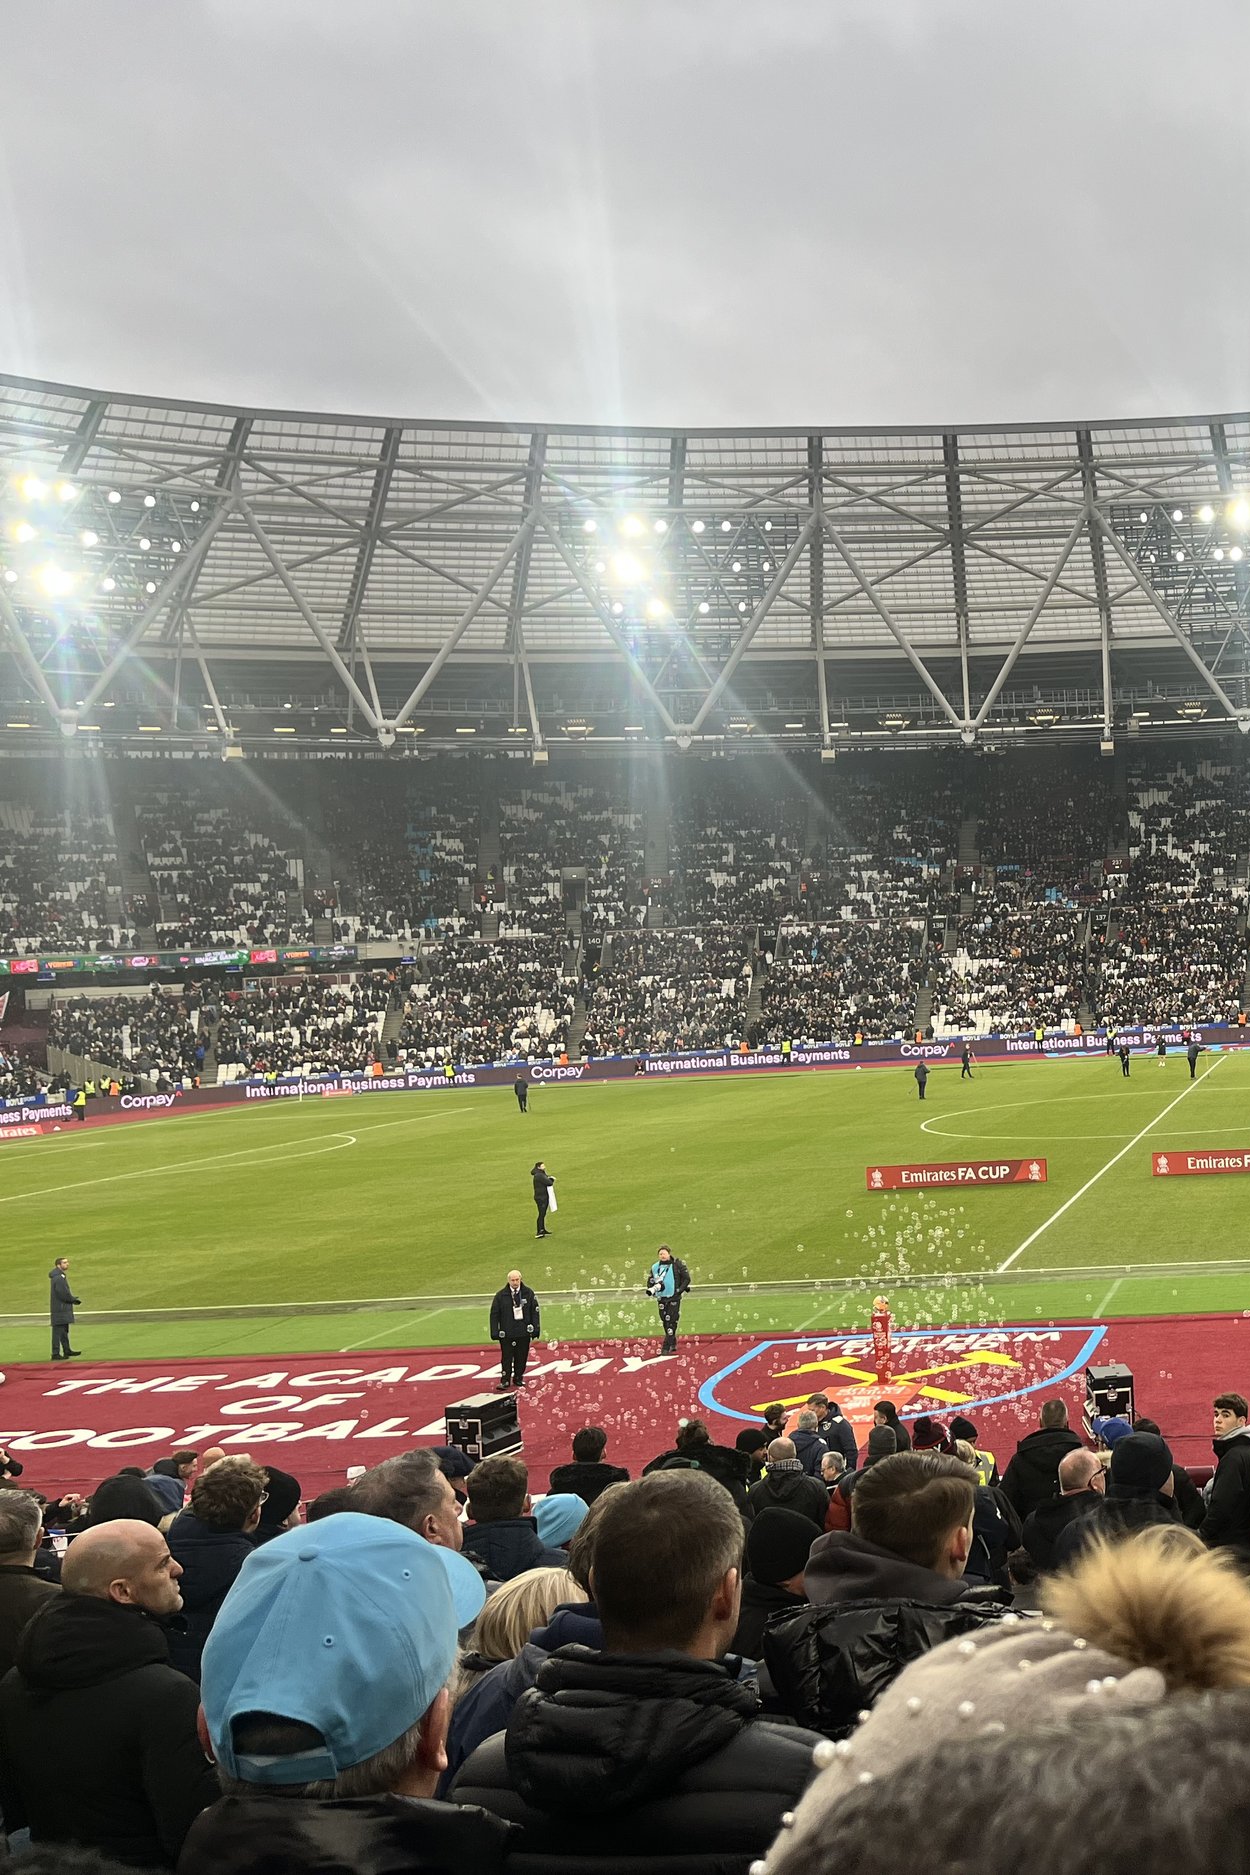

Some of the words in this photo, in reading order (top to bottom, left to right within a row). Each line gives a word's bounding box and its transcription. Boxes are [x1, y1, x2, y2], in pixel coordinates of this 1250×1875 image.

[1086, 1034, 1140, 1047] Busness
[1143, 1032, 1202, 1046] Pamets
[900, 1042, 949, 1057] Corpay
[646, 1053, 727, 1071] International
[790, 1050, 850, 1063] Payments
[531, 1064, 584, 1079] Corpay
[342, 1076, 404, 1090] Business
[120, 1093, 176, 1109] Corpay
[22, 1104, 72, 1122] Payments
[1187, 1156, 1242, 1169] Emirates
[902, 1170, 956, 1182] Emirates
[958, 1168, 976, 1180] FA
[978, 1166, 1010, 1179] CUP
[796, 1337, 929, 1352] WET
[935, 1331, 1061, 1346] HAM
[842, 1341, 1001, 1356] UITED
[42, 1374, 229, 1396] THE
[220, 1392, 366, 1414] OF
